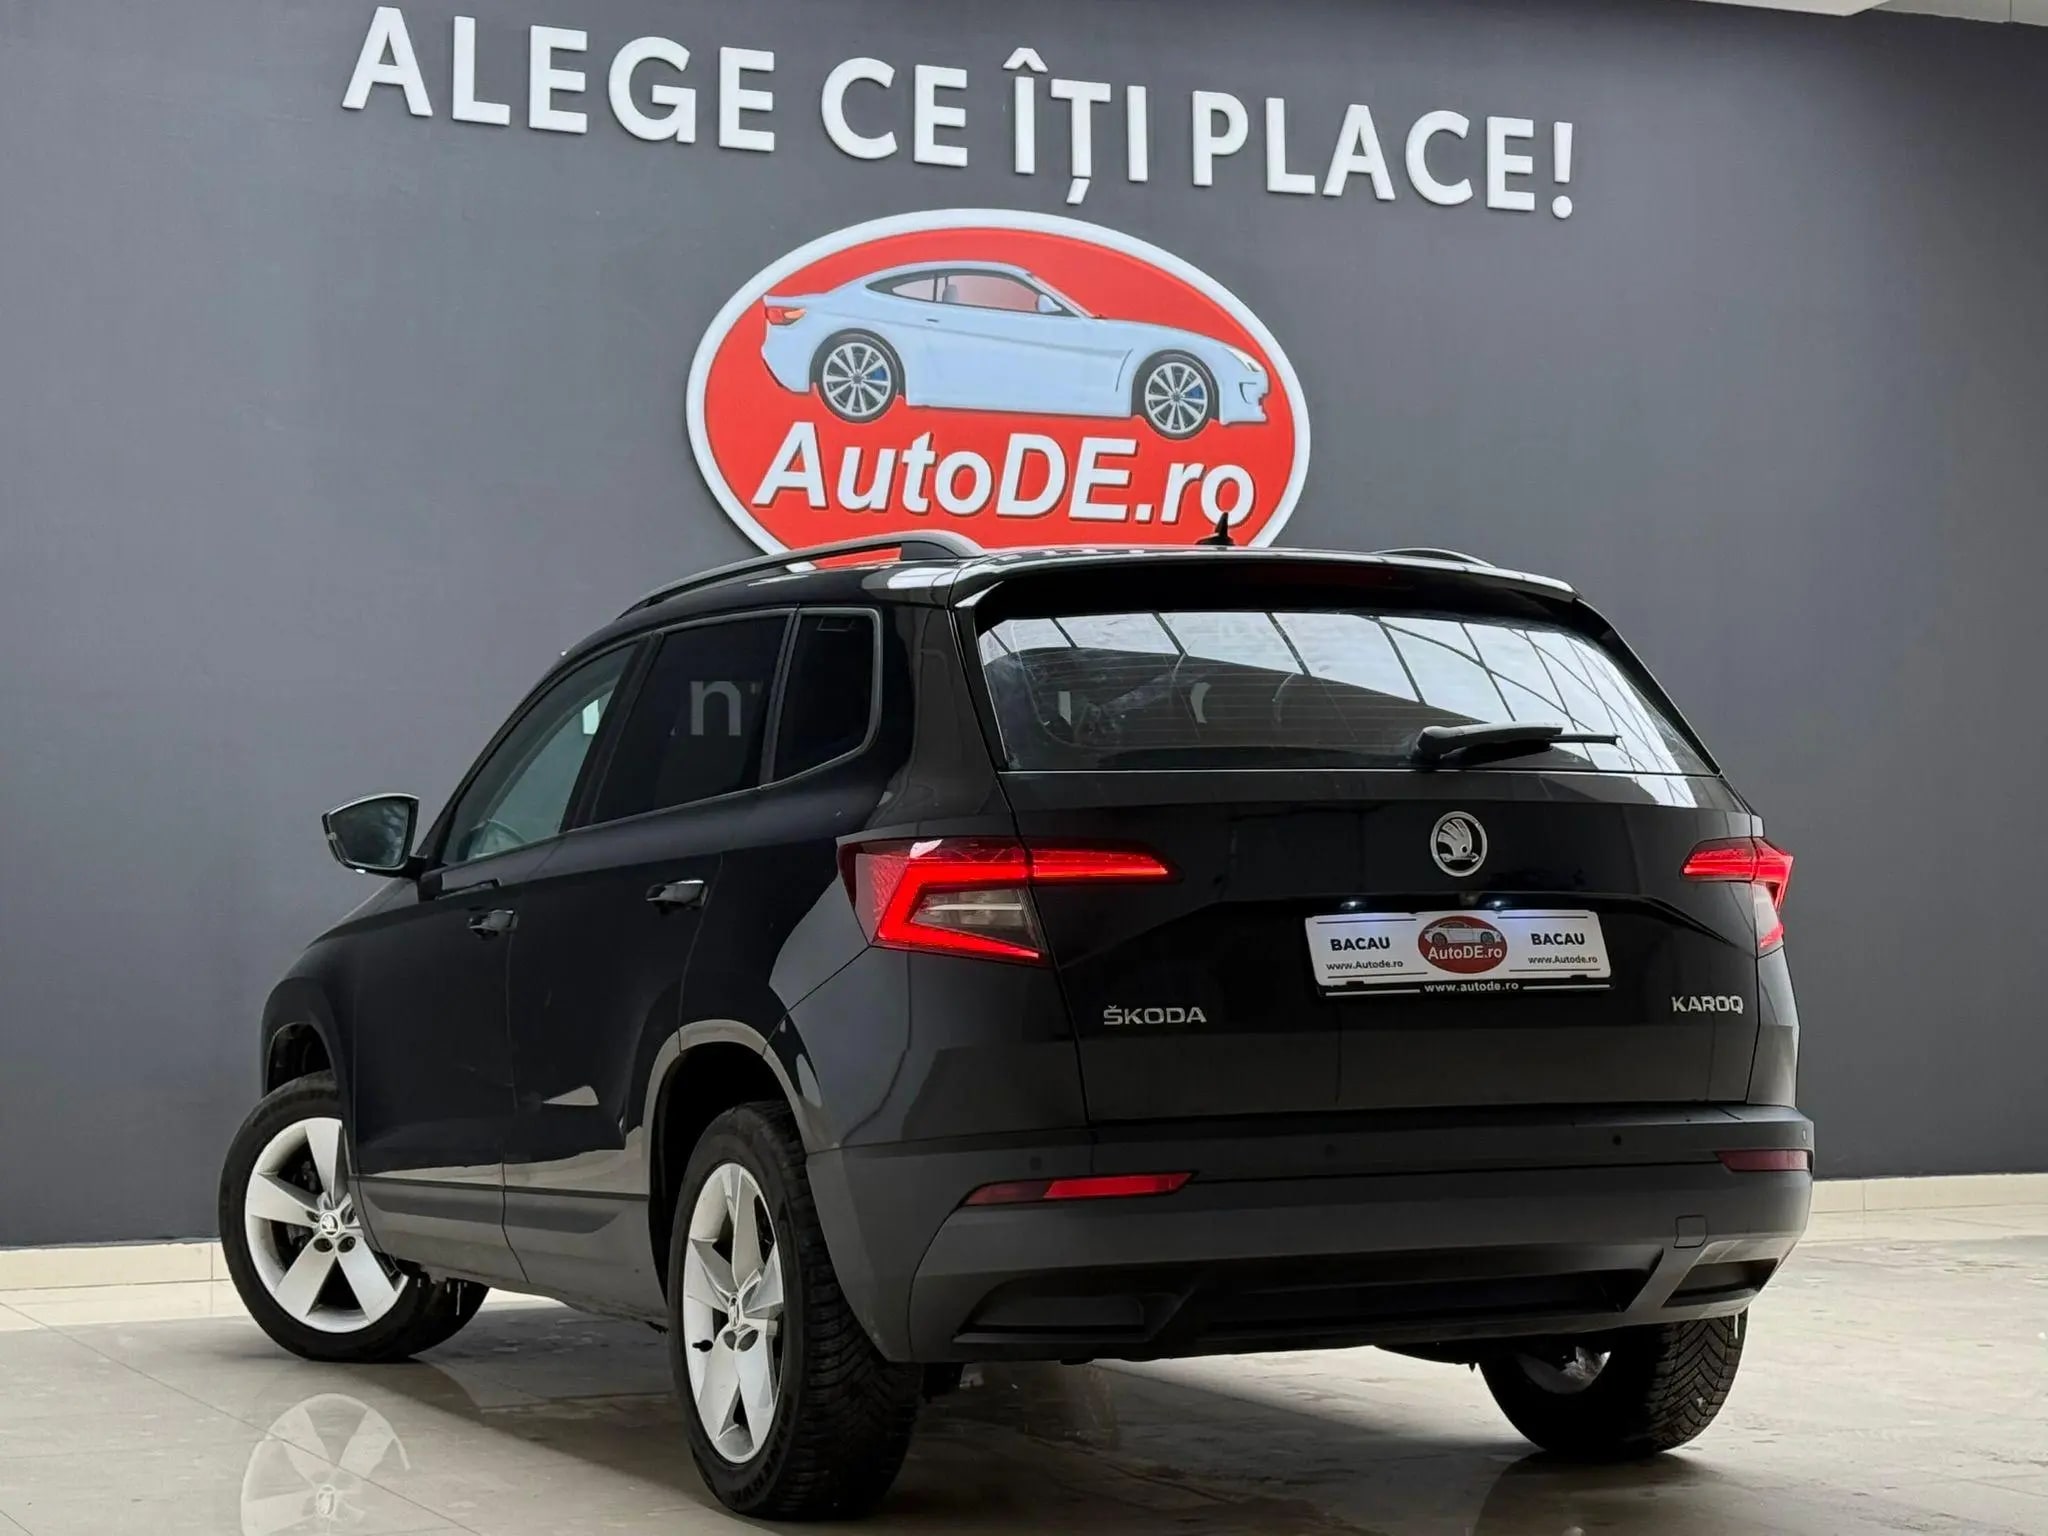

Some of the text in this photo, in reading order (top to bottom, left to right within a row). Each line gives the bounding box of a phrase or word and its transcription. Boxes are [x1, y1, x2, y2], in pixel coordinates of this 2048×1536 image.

[342, 6, 1573, 219] ALEGE CE ÎȚI PLACE!
[751, 421, 1255, 528] AutoDE.ro
[1330, 936, 1391, 951] BACAU
[1531, 933, 1586, 946] BACAU
[1427, 945, 1503, 960] AutoDE.ro
[1528, 955, 1598, 965] www.Autode.ro
[1326, 959, 1404, 970] www.Autode.ro
[1424, 981, 1519, 993] www.autode.ro
[1671, 995, 1744, 1014] KAROQ
[1103, 1005, 1207, 1025] ŠKODA
